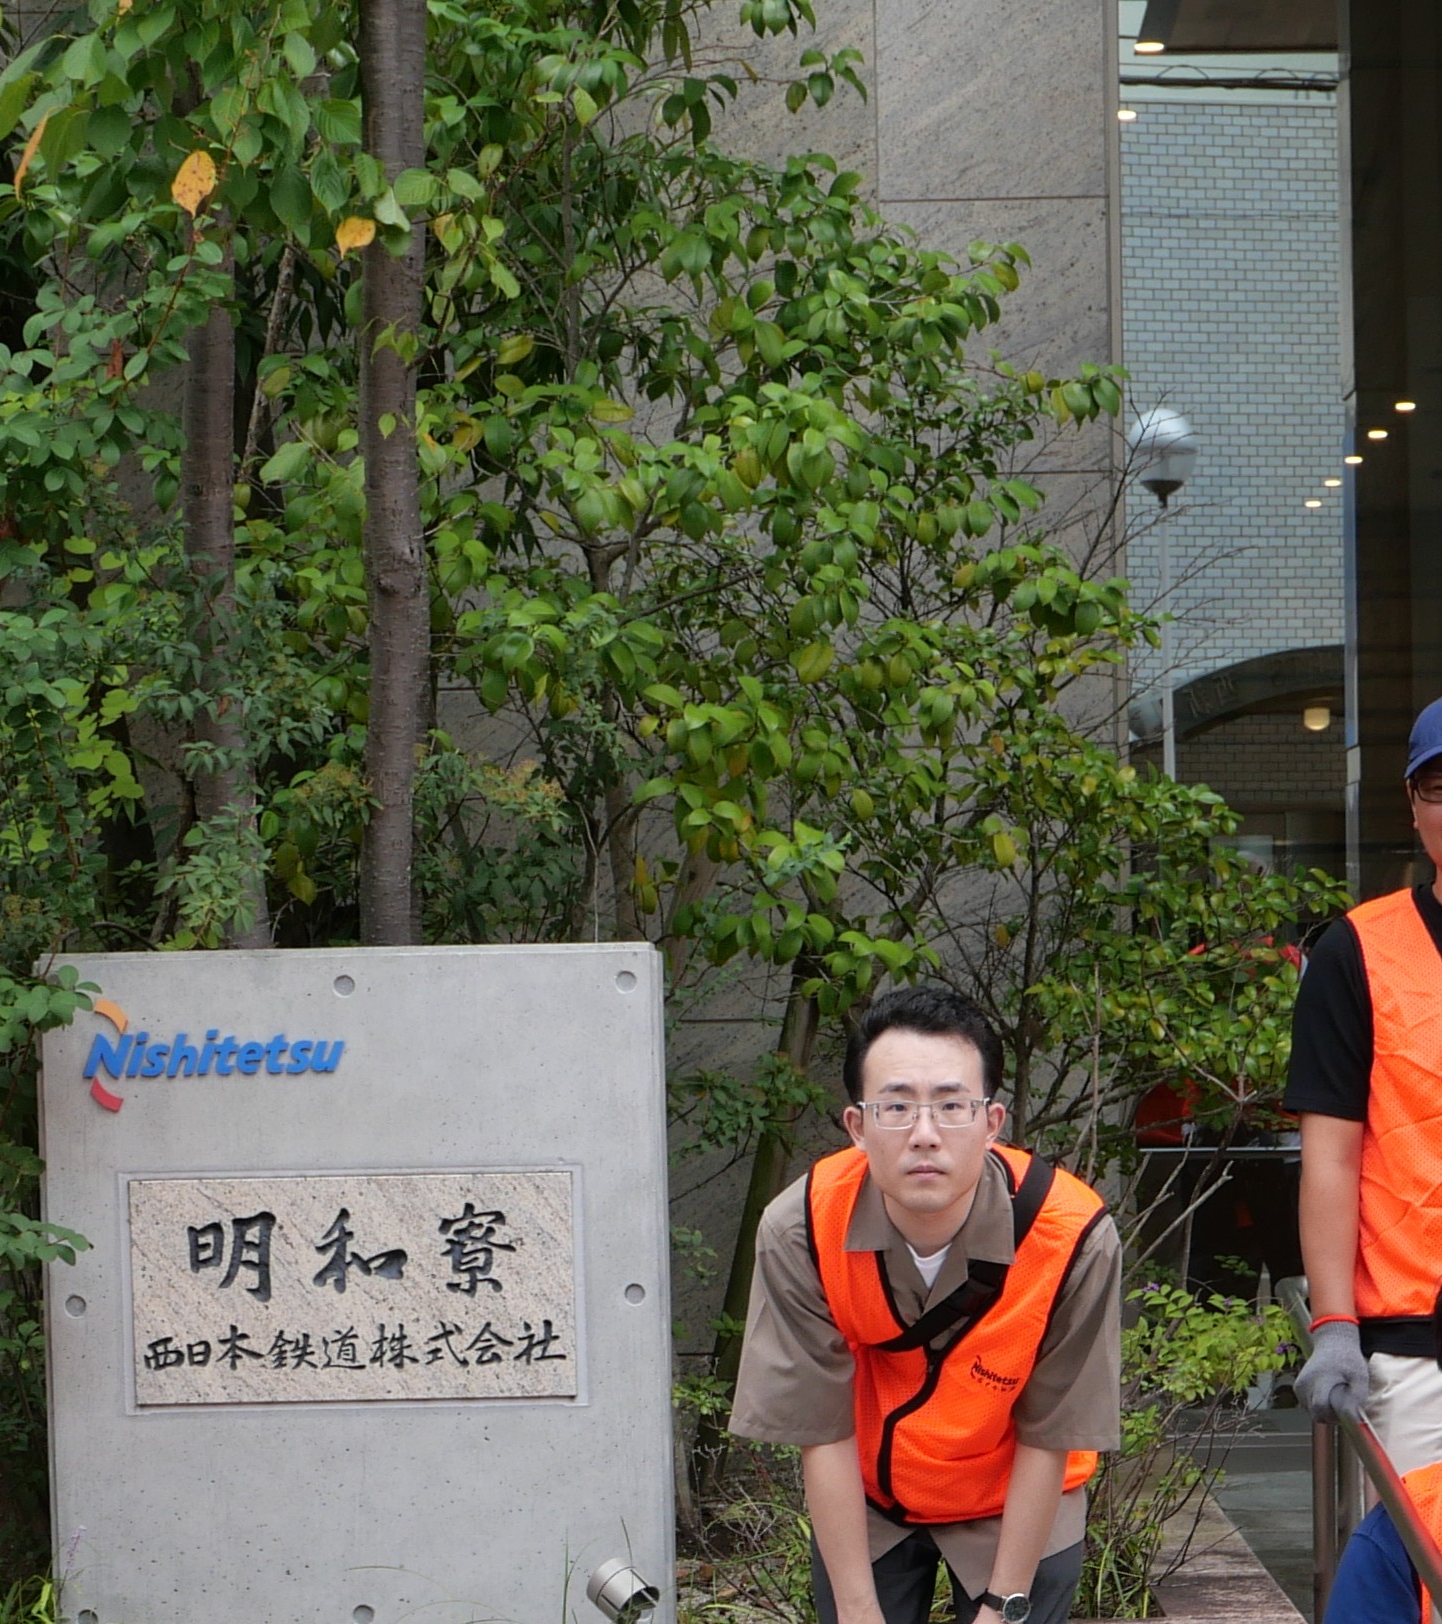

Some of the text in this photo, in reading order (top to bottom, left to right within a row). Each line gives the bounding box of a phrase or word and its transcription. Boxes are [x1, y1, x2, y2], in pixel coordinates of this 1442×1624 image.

[83, 1029, 344, 1080] Nishitetsu
[186, 1202, 517, 1301] 明和寮
[143, 1318, 568, 1373] 西日本鉄道株式会社
